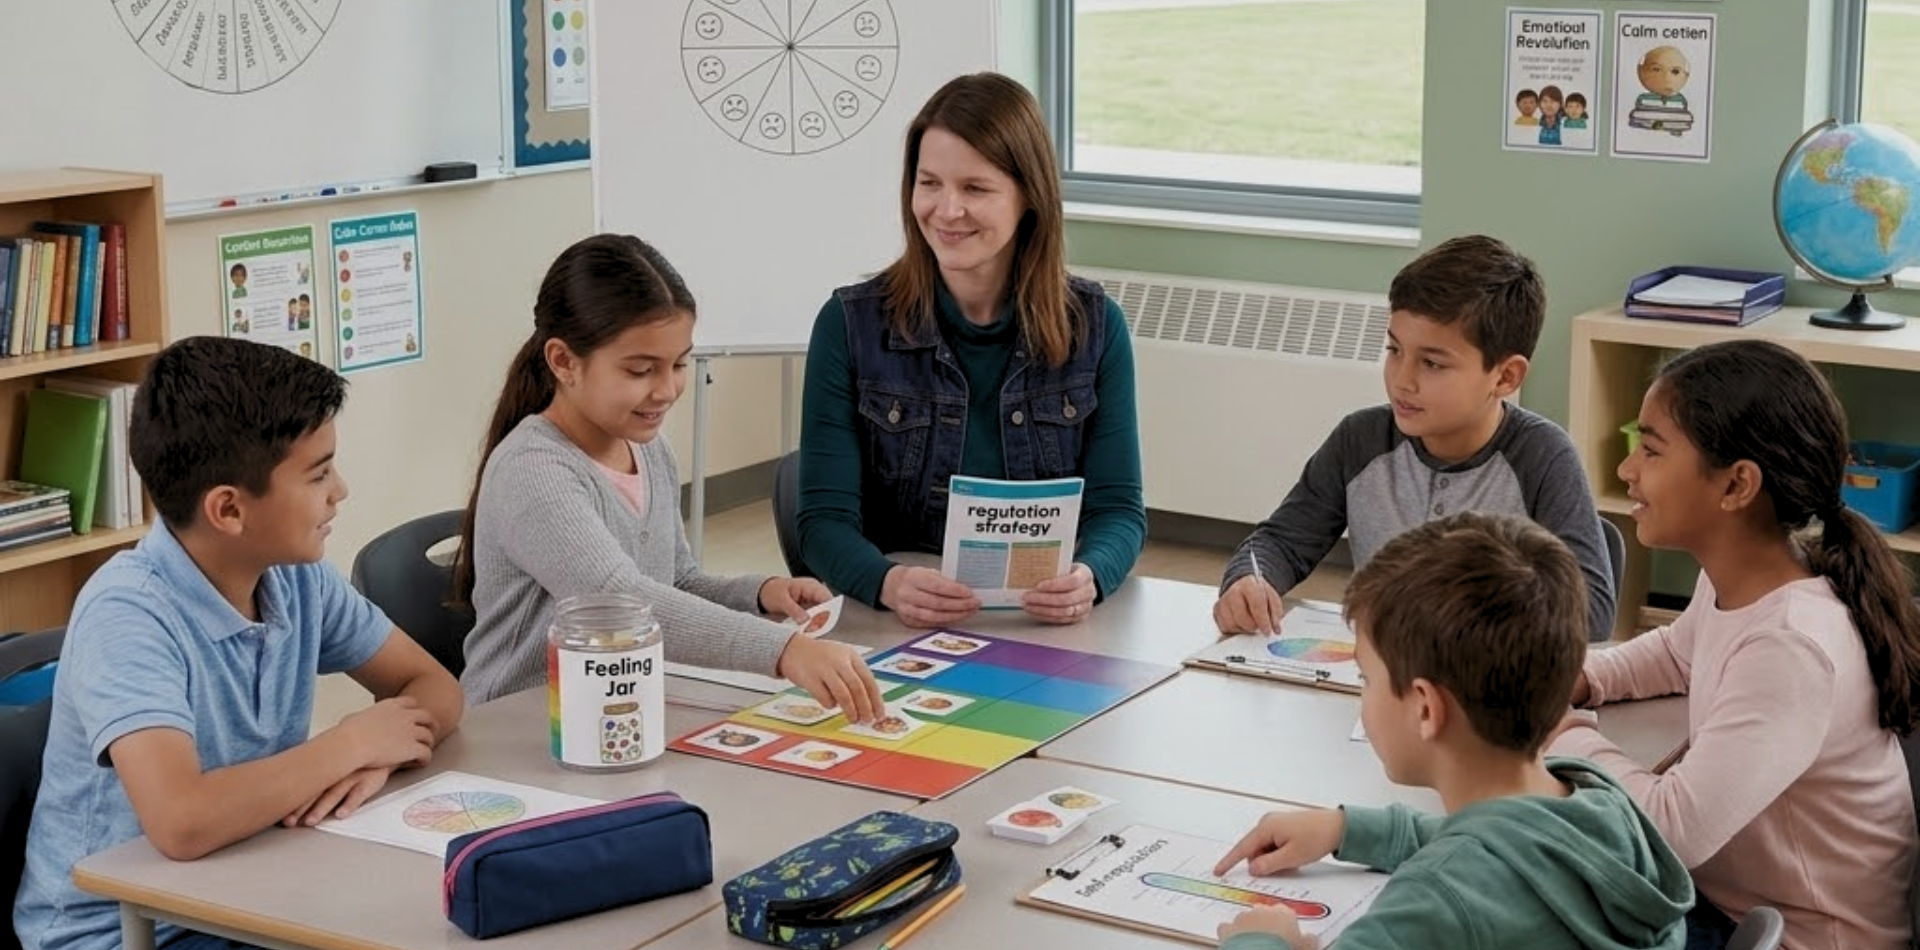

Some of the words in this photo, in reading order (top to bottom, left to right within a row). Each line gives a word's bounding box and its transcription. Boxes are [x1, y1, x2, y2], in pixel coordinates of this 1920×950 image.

[1621, 24, 1657, 38] Calm
[584, 657, 653, 676] Feeling
[605, 681, 636, 697] Jar
